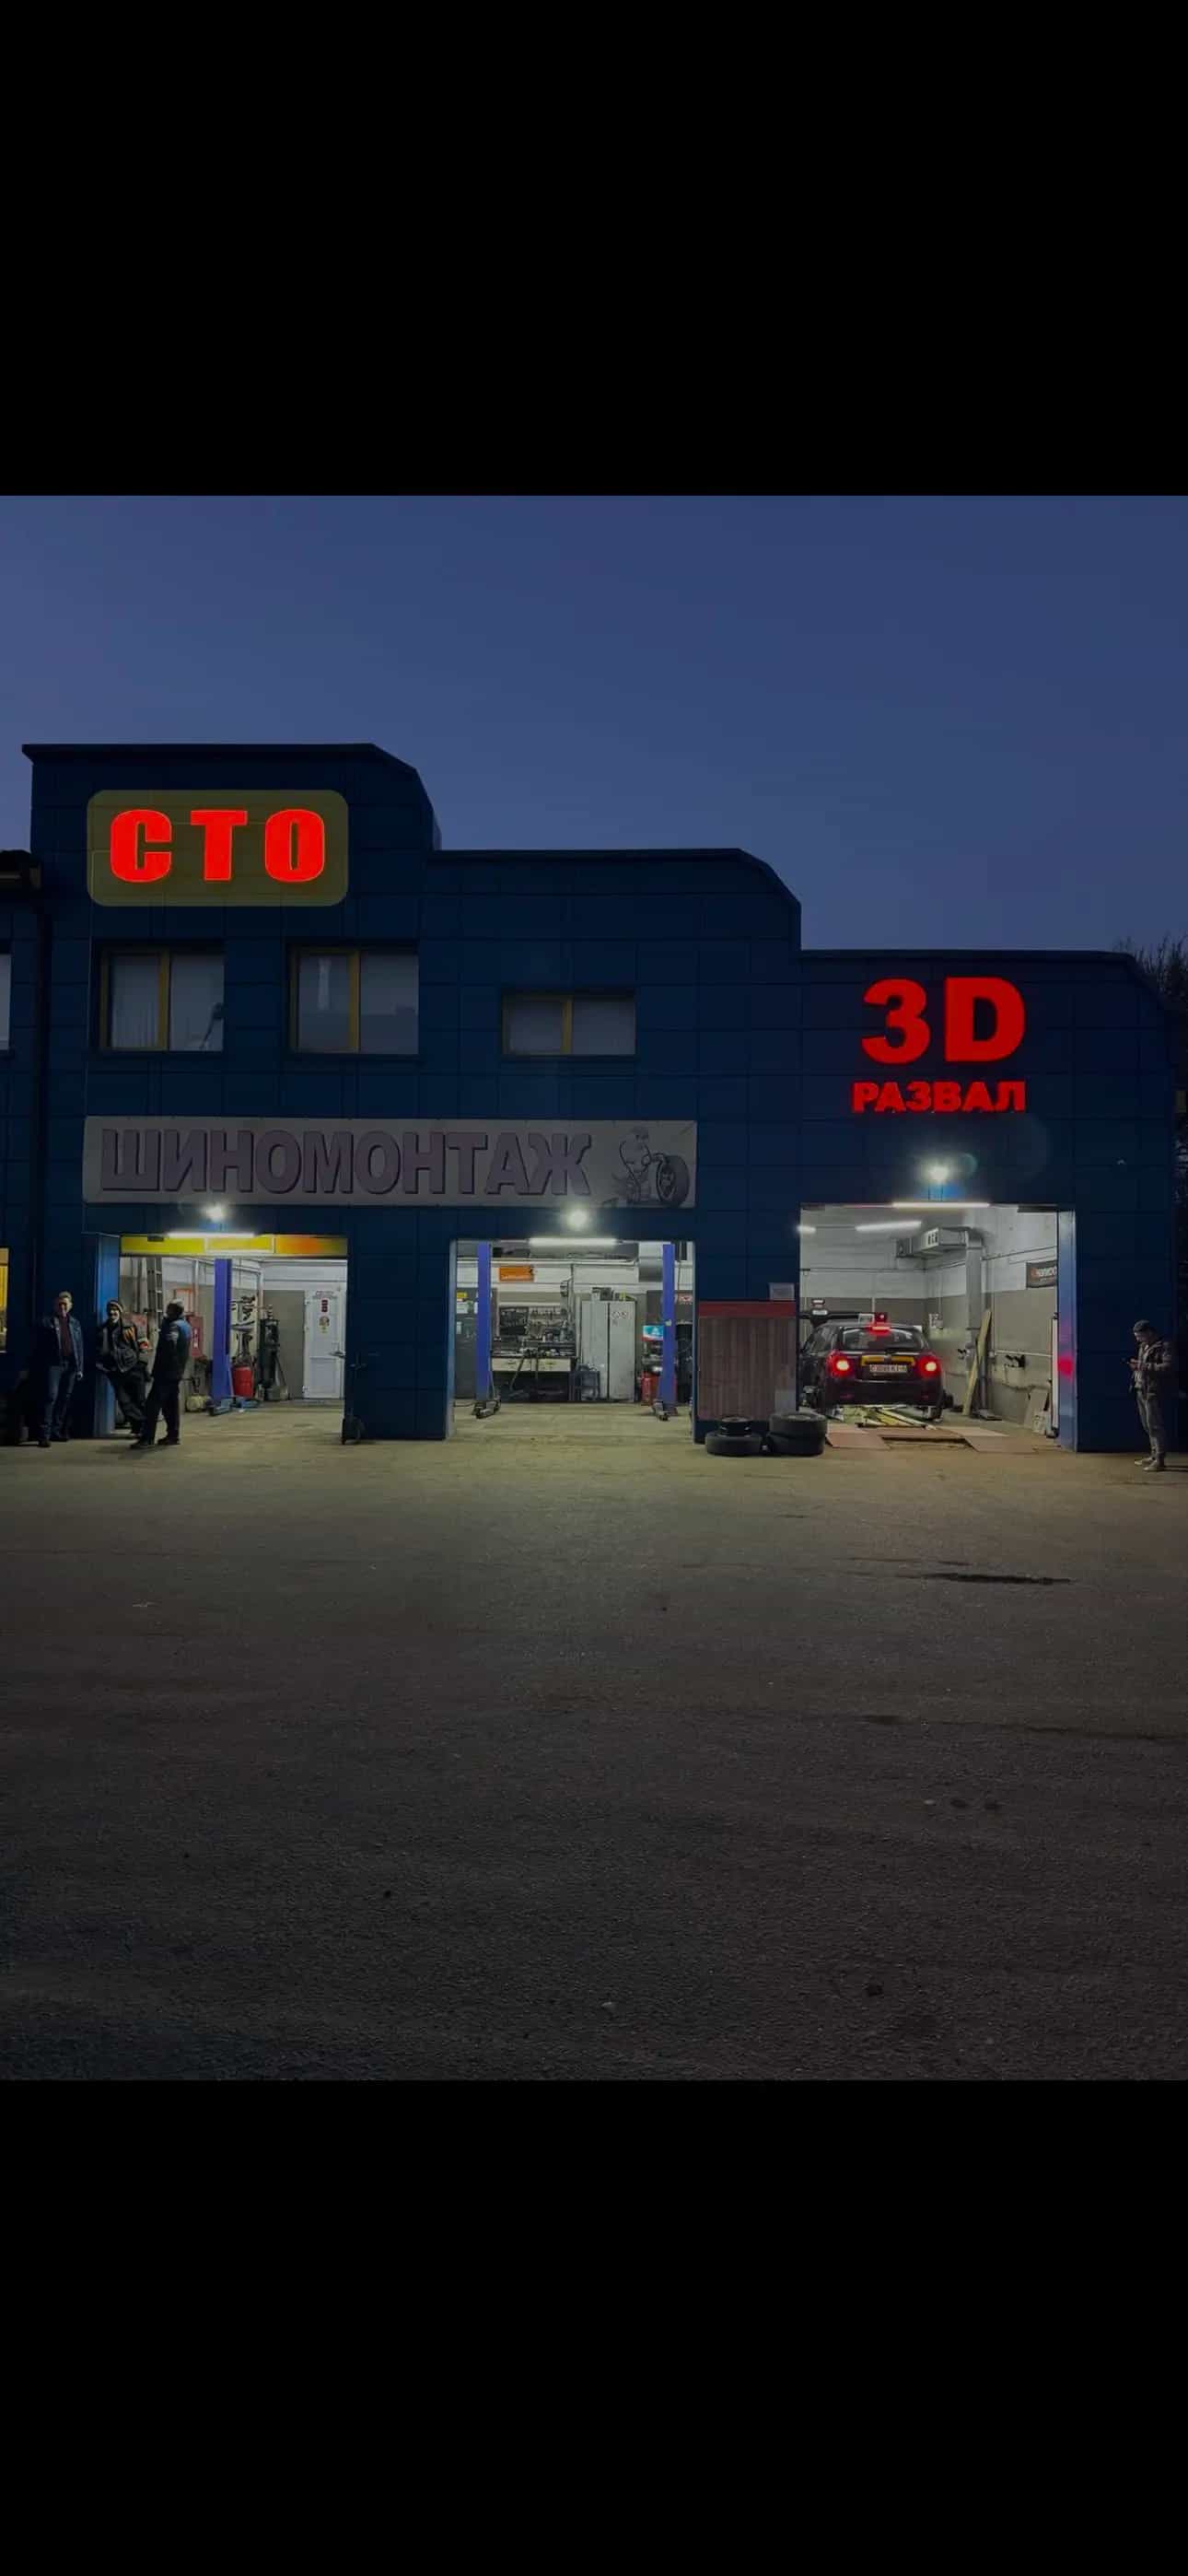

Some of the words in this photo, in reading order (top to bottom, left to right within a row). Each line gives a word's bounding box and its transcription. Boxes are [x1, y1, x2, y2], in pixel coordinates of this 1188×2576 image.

[110, 809, 326, 884] СТО
[861, 975, 1027, 1066] 3D
[851, 1078, 1027, 1114] РАЗВАЛ
[99, 1128, 591, 1197] ШИНОМОНТАЖ
